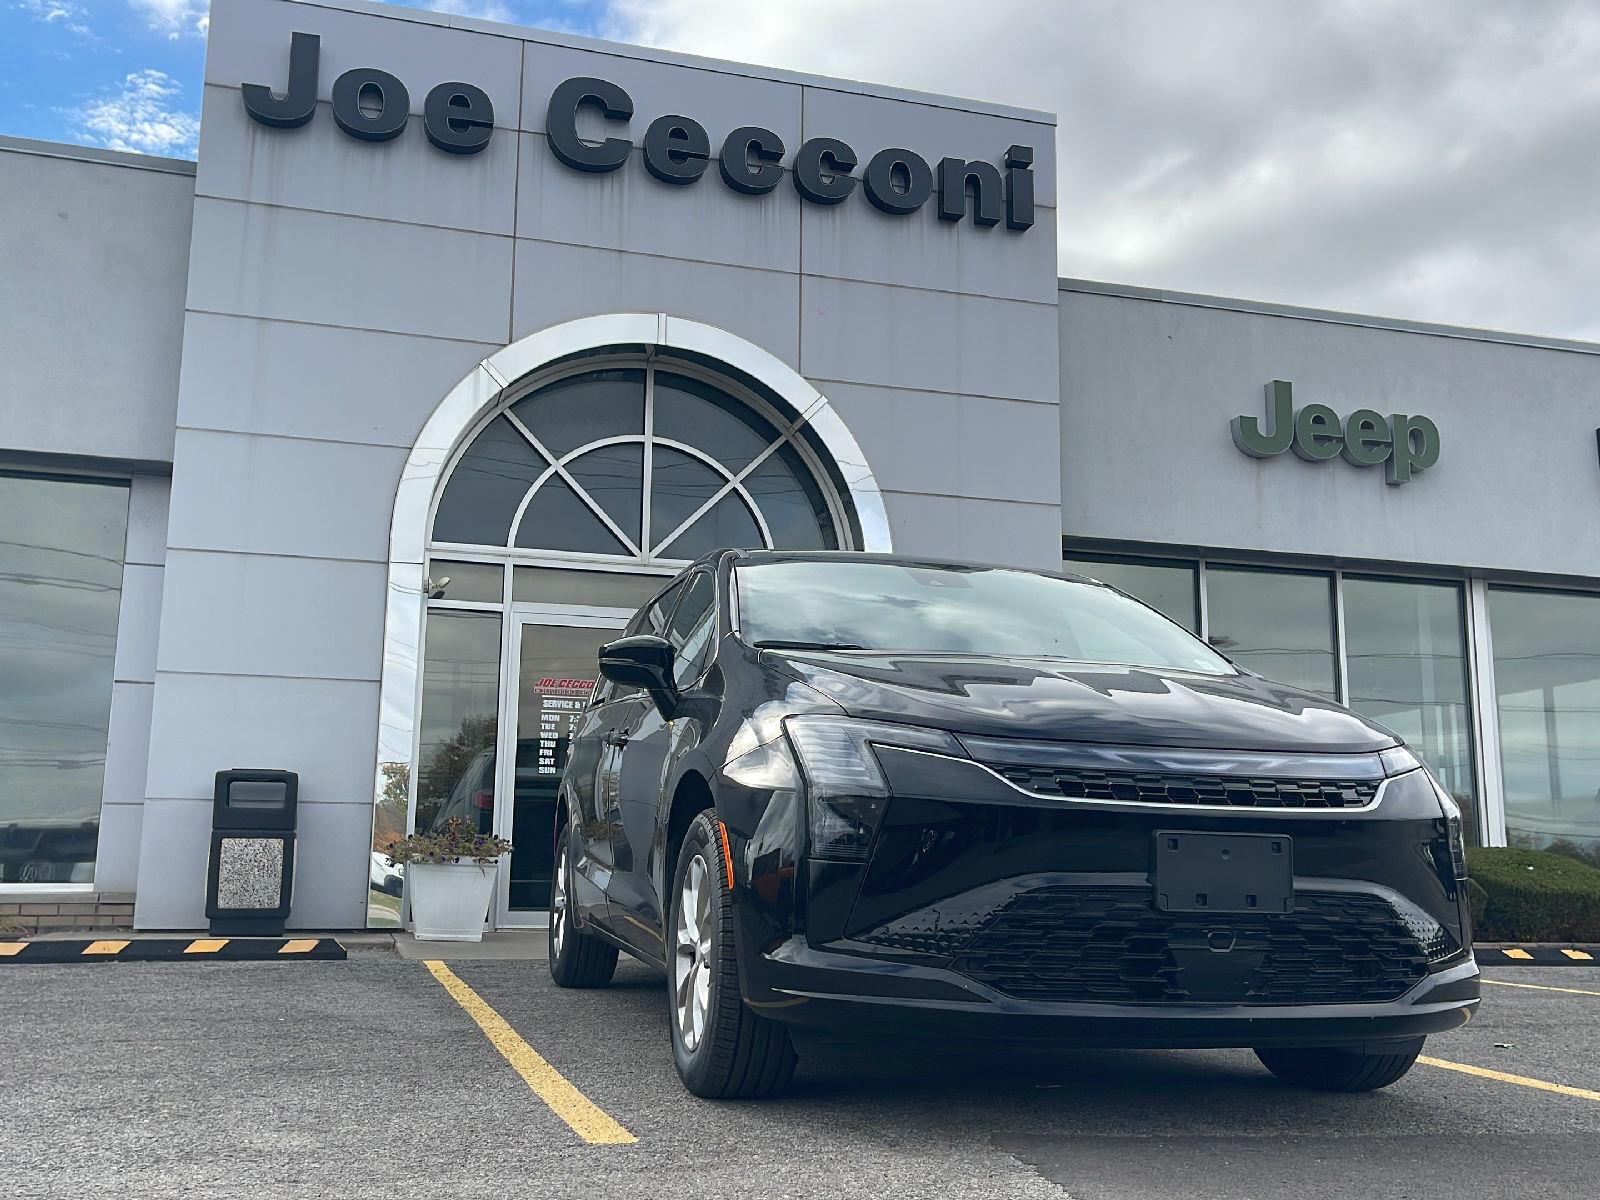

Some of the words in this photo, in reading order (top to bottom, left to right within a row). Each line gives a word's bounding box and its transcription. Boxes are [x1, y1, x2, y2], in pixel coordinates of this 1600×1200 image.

[242, 31, 494, 155] Joe
[546, 77, 1035, 231] Cecconi
[1230, 379, 1440, 486] Jeep
[543, 699, 573, 709] SERVICE
[541, 714, 560, 722] MON
[540, 740, 556, 748] THU
[539, 766, 556, 774] SUN
